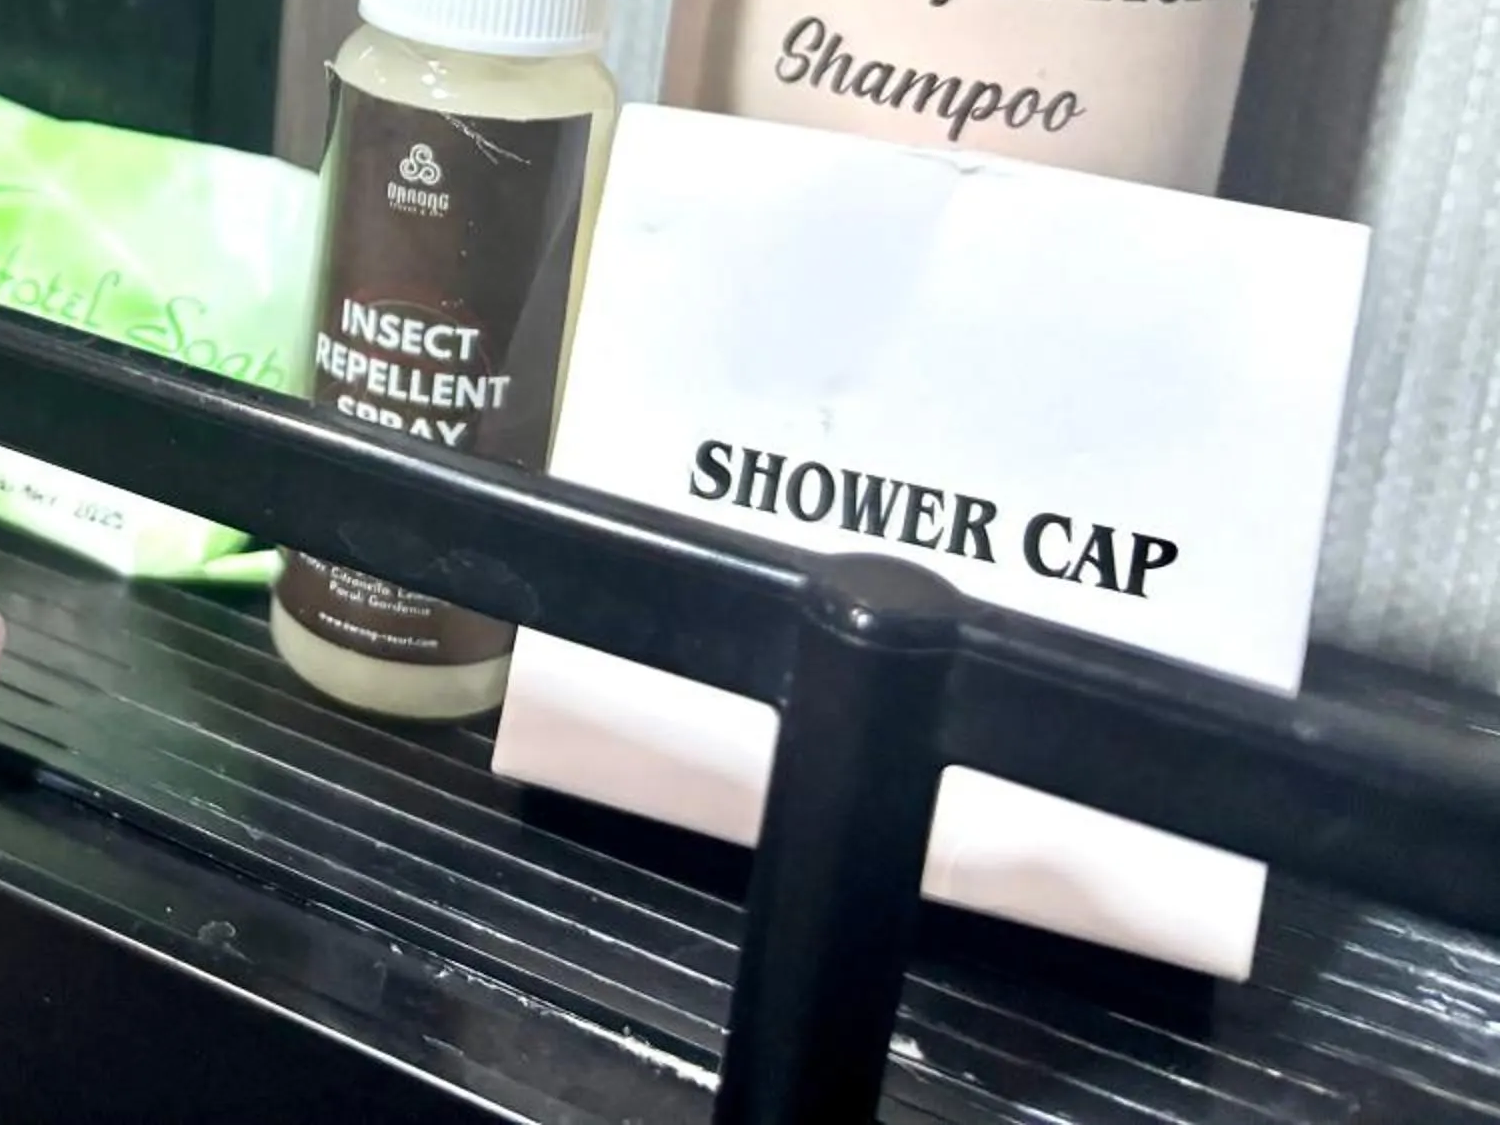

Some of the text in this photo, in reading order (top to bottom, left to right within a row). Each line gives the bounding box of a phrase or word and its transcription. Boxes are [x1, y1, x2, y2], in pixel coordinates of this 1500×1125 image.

[774, 17, 1086, 142] Shampoo
[316, 332, 510, 408] REPELLENT
[341, 299, 479, 362] INSECT
[689, 439, 1179, 598] SHOWER CAP
